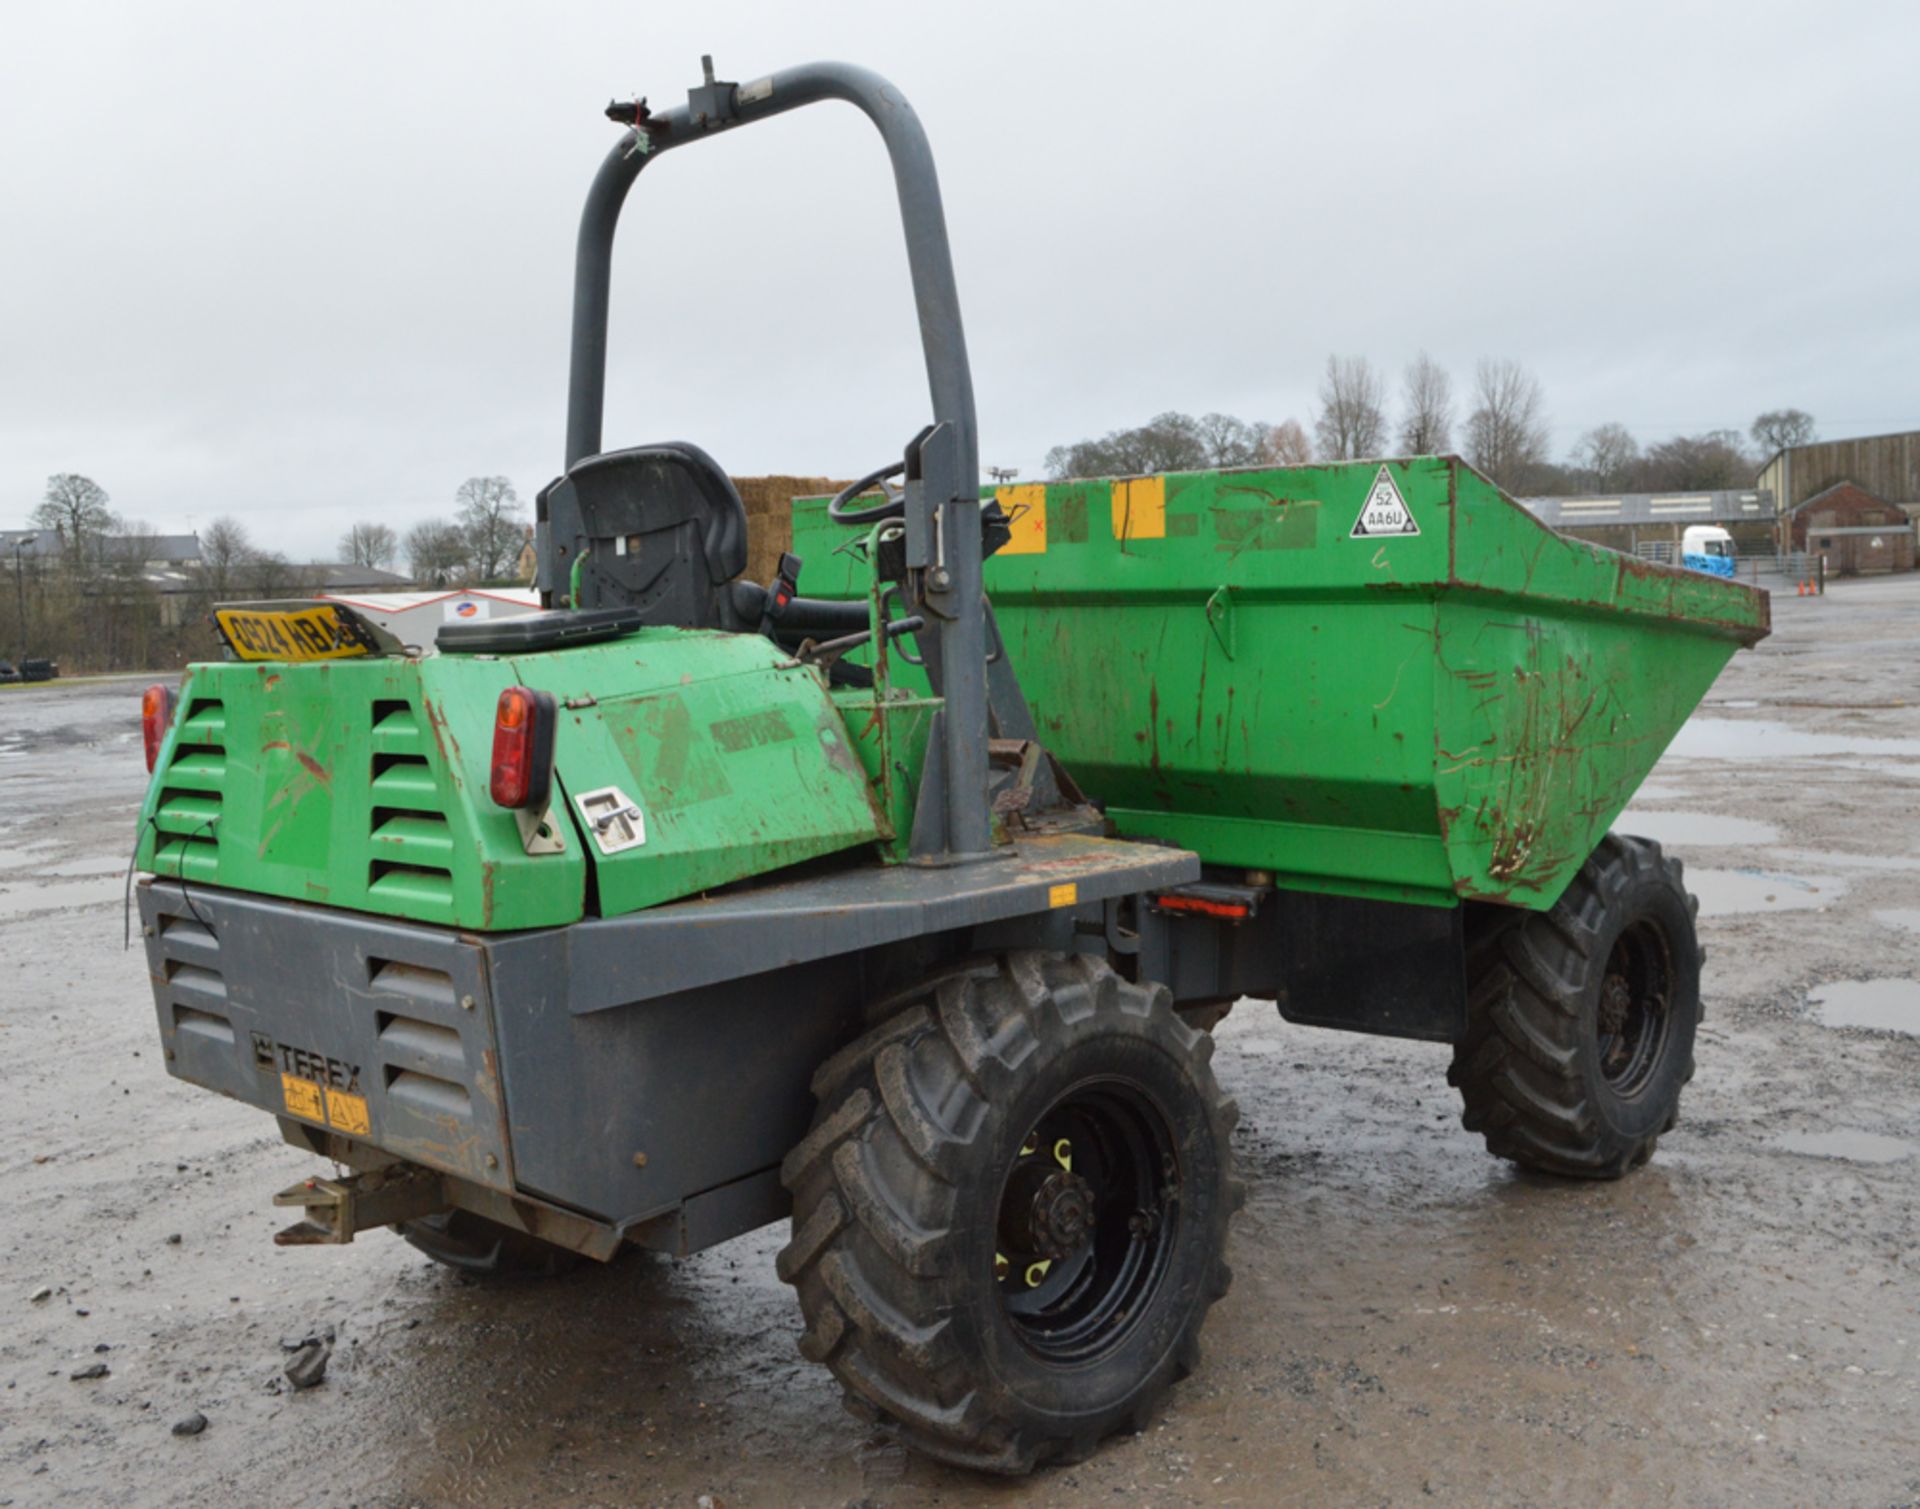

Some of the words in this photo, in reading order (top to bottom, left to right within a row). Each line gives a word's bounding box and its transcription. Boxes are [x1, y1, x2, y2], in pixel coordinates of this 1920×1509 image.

[1375, 491, 1393, 506] 52
[1368, 511, 1403, 525] AA6U
[276, 1043, 363, 1095] TEREX
